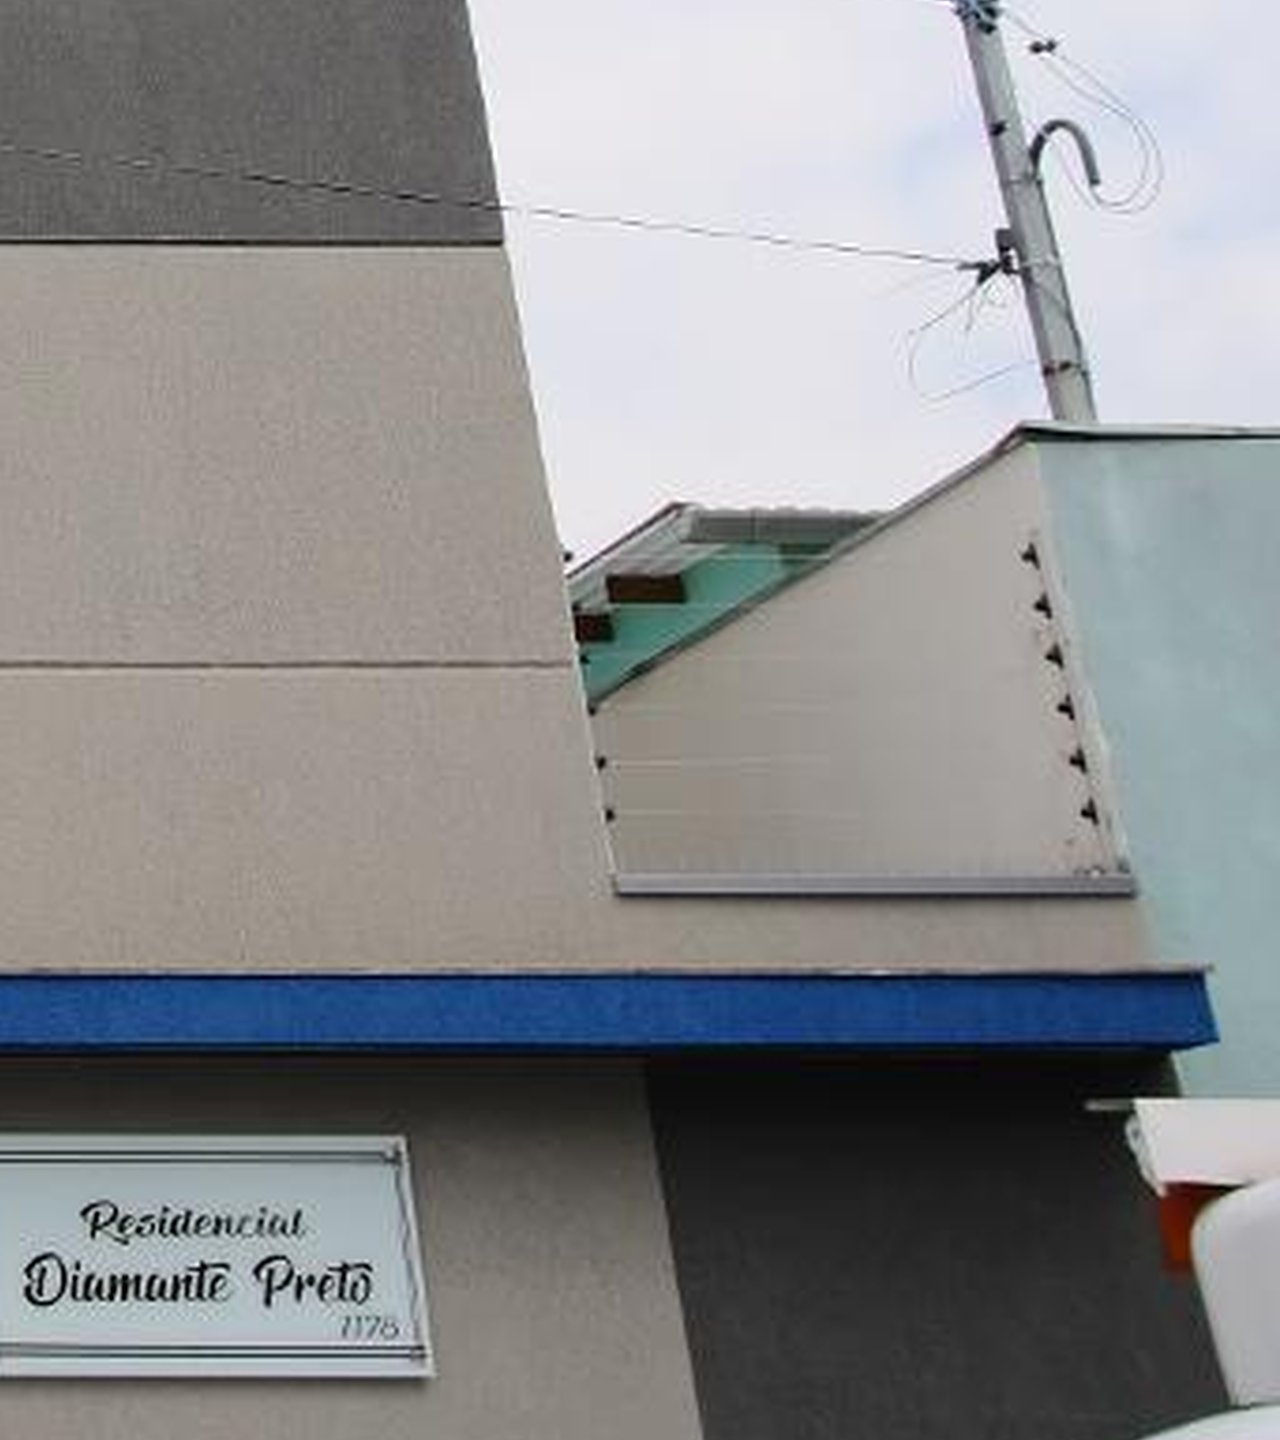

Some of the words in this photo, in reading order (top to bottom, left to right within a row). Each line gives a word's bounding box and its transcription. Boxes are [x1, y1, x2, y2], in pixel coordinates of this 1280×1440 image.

[80, 1200, 306, 1245] Residencial
[23, 1251, 233, 1307] Diamante
[253, 1255, 374, 1308] Preto
